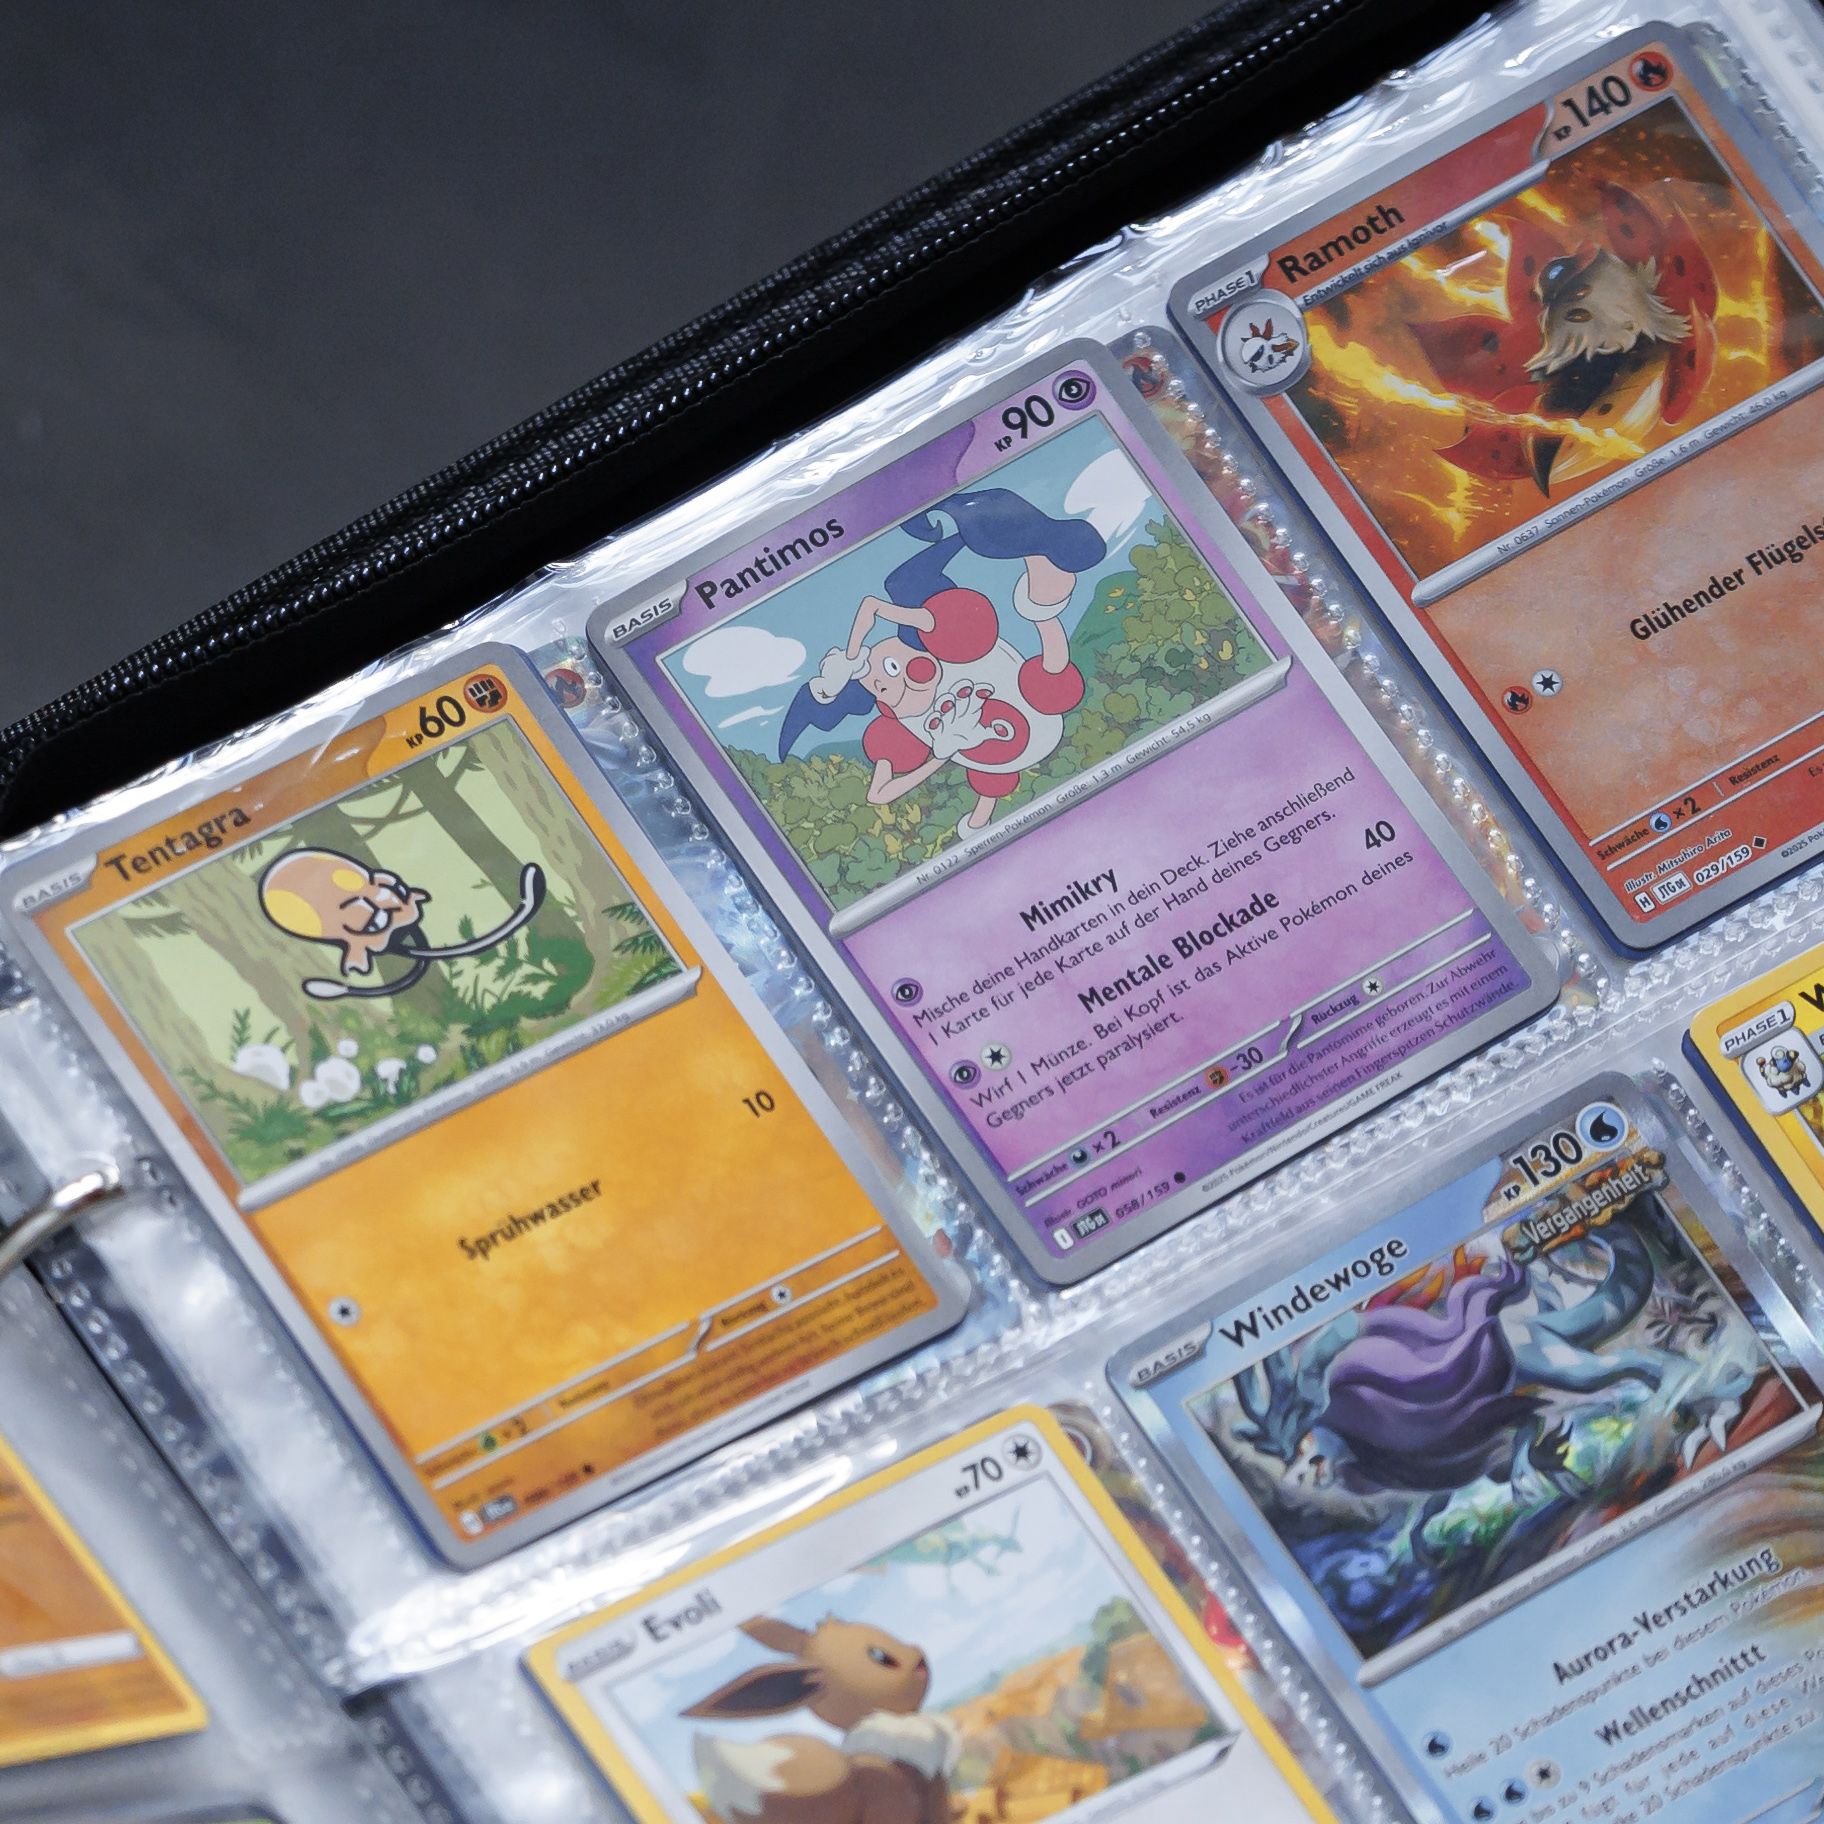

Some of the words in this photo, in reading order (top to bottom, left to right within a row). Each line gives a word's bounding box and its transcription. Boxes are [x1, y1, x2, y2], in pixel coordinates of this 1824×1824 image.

[1561, 74, 1632, 127] 140
[1276, 204, 1405, 283] Ramoth
[1000, 393, 1055, 439] 90
[694, 518, 844, 609] Pantimos
[611, 597, 672, 639] BASIS
[1629, 568, 1745, 640] Glühender
[418, 694, 466, 739] 60
[104, 807, 250, 881] Tentagra
[1363, 819, 1396, 850] 40
[1694, 845, 1754, 883] 029/159
[911, 990, 970, 1029] Mische
[971, 965, 1016, 995] deine
[1012, 911, 1108, 970] Handkarten
[1106, 901, 1126, 917] in
[1126, 880, 1162, 906] dein
[1158, 853, 1210, 886] Deck.
[1205, 826, 1257, 859] Ziehe
[1256, 765, 1355, 832] anschließend
[939, 1006, 991, 1039] Karte
[989, 989, 1015, 1011] für
[1016, 969, 1055, 1000] jede
[1053, 940, 1104, 974] Karte
[1104, 919, 1131, 946] auf
[1133, 905, 1160, 929] der
[1160, 875, 1209, 912] Hand
[1210, 849, 1263, 884] deines
[1262, 809, 1336, 852] Gegners.
[1019, 868, 1118, 932] Mimikry
[968, 1075, 1014, 1108] Wirf
[1029, 1038, 1092, 1076] Münze.
[1091, 1014, 1123, 1040] Bei
[1122, 987, 1166, 1023] Kopf
[1165, 978, 1192, 998] ist
[1193, 960, 1223, 983] das
[1225, 928, 1279, 966] Aktive
[1278, 883, 1358, 932] Pokémon
[1360, 850, 1414, 886] deines
[1076, 953, 1173, 1014] Mentale
[1171, 892, 1279, 959] Blockade
[740, 1089, 776, 1119] 10
[985, 1084, 1055, 1128] Gegners
[1053, 1061, 1096, 1094] jetzt
[1095, 1011, 1184, 1070] paralysiert.
[1512, 1131, 1583, 1187] 130
[457, 1179, 601, 1261] Sprühwasser
[1521, 1163, 1650, 1244] Vergangenheit
[1219, 1239, 1407, 1347] Windewoge
[960, 1455, 1004, 1491] 70
[641, 1588, 721, 1643] Evoli
